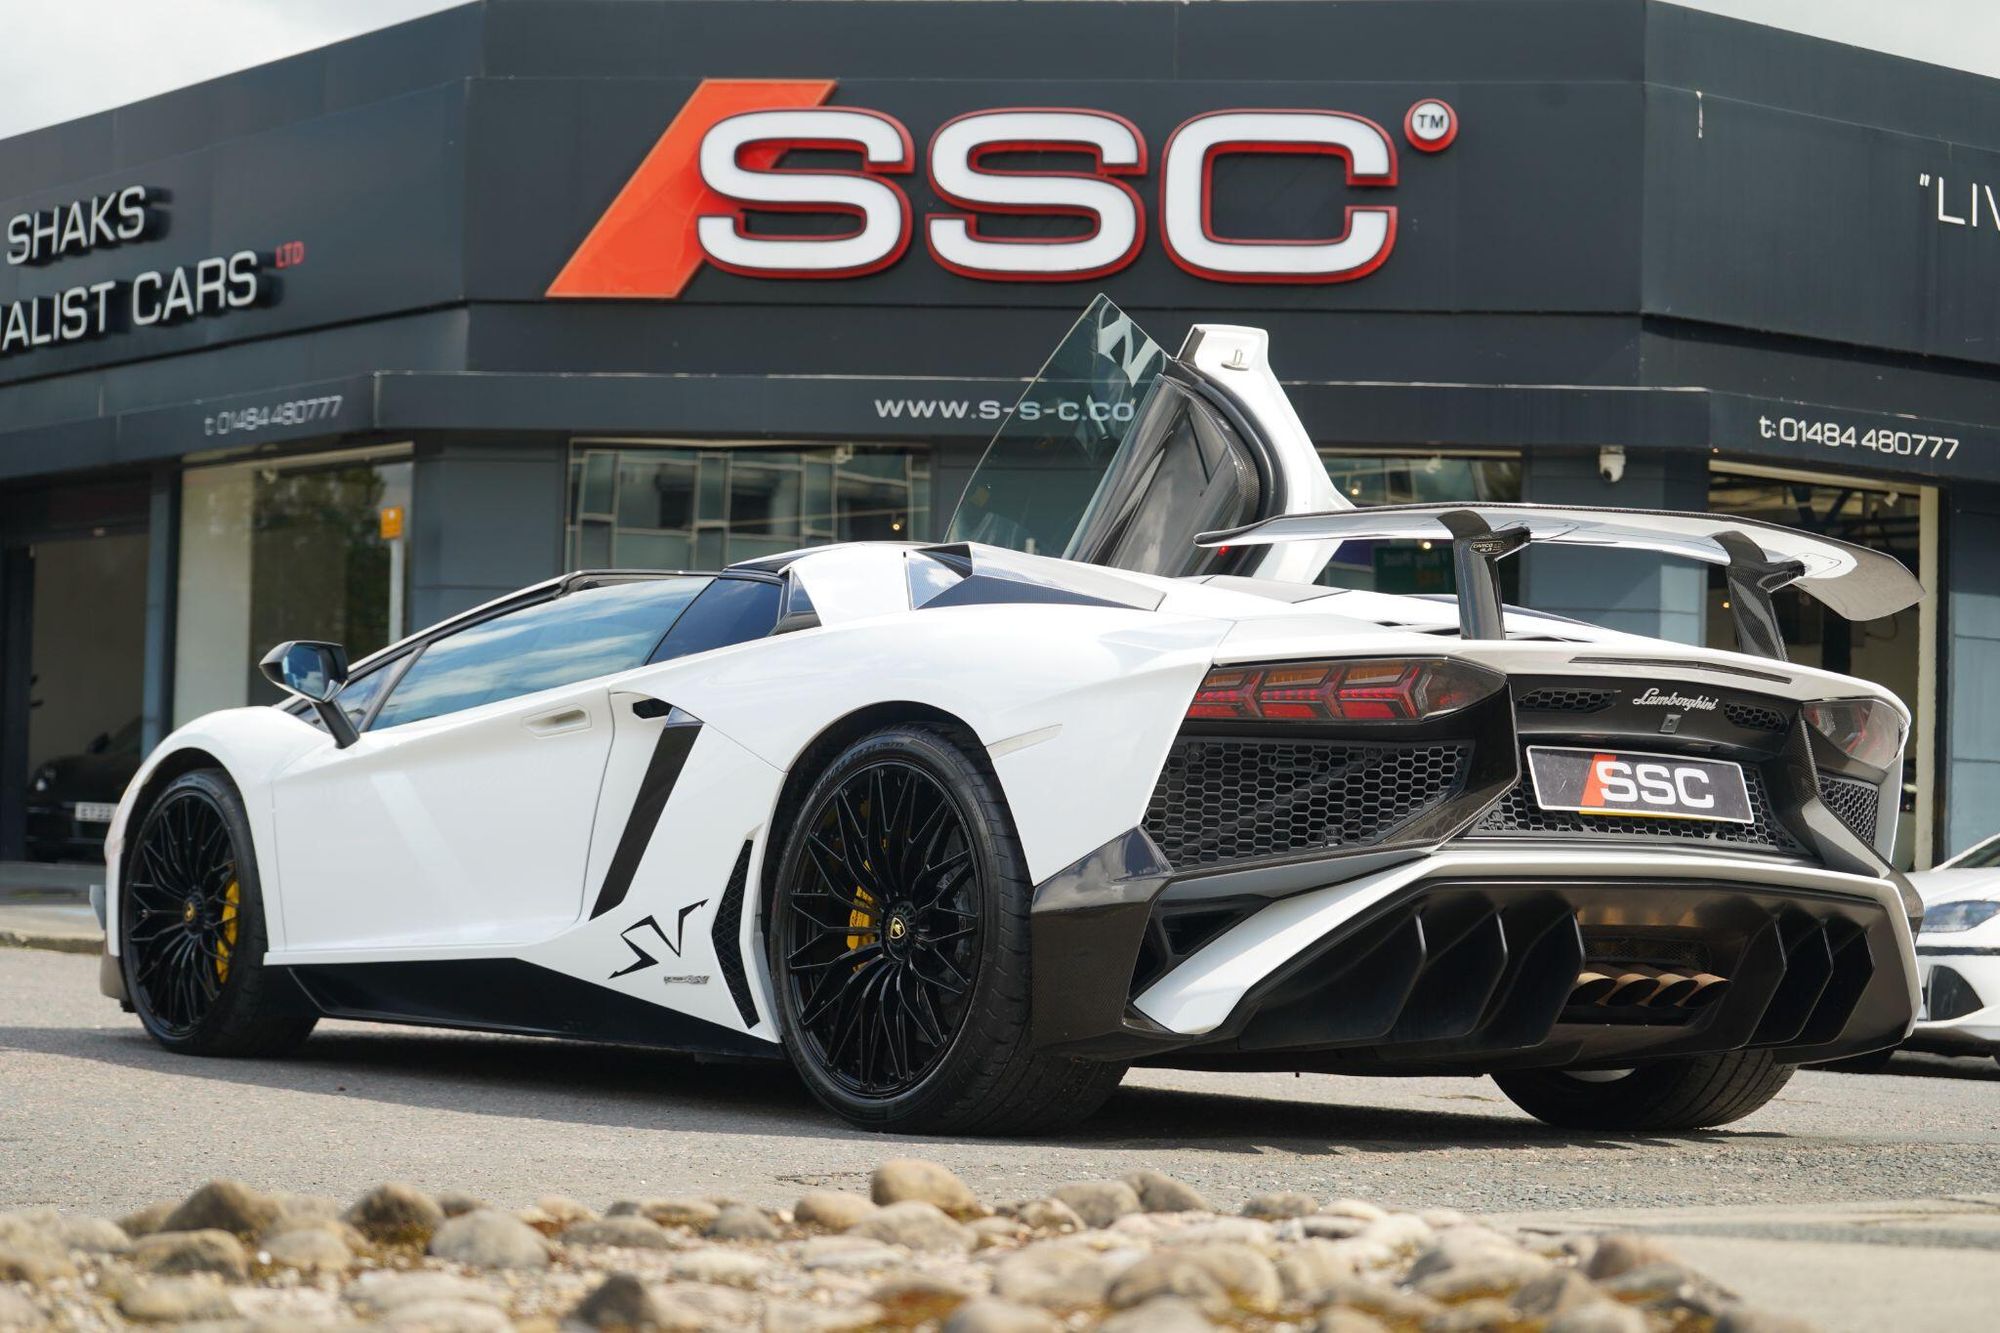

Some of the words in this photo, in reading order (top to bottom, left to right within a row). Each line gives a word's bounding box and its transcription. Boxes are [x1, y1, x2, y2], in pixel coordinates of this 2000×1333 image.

[1417, 114, 1444, 129] TM
[695, 106, 1398, 284] SSC
[6, 185, 146, 266] SHAKS
[0, 280, 116, 351] ALIST
[132, 250, 258, 326] CARS
[275, 240, 305, 269] LTD
[1860, 428, 1960, 460] 480777
[1632, 687, 1719, 711] Lamborghini
[1595, 760, 1715, 809] SSC
